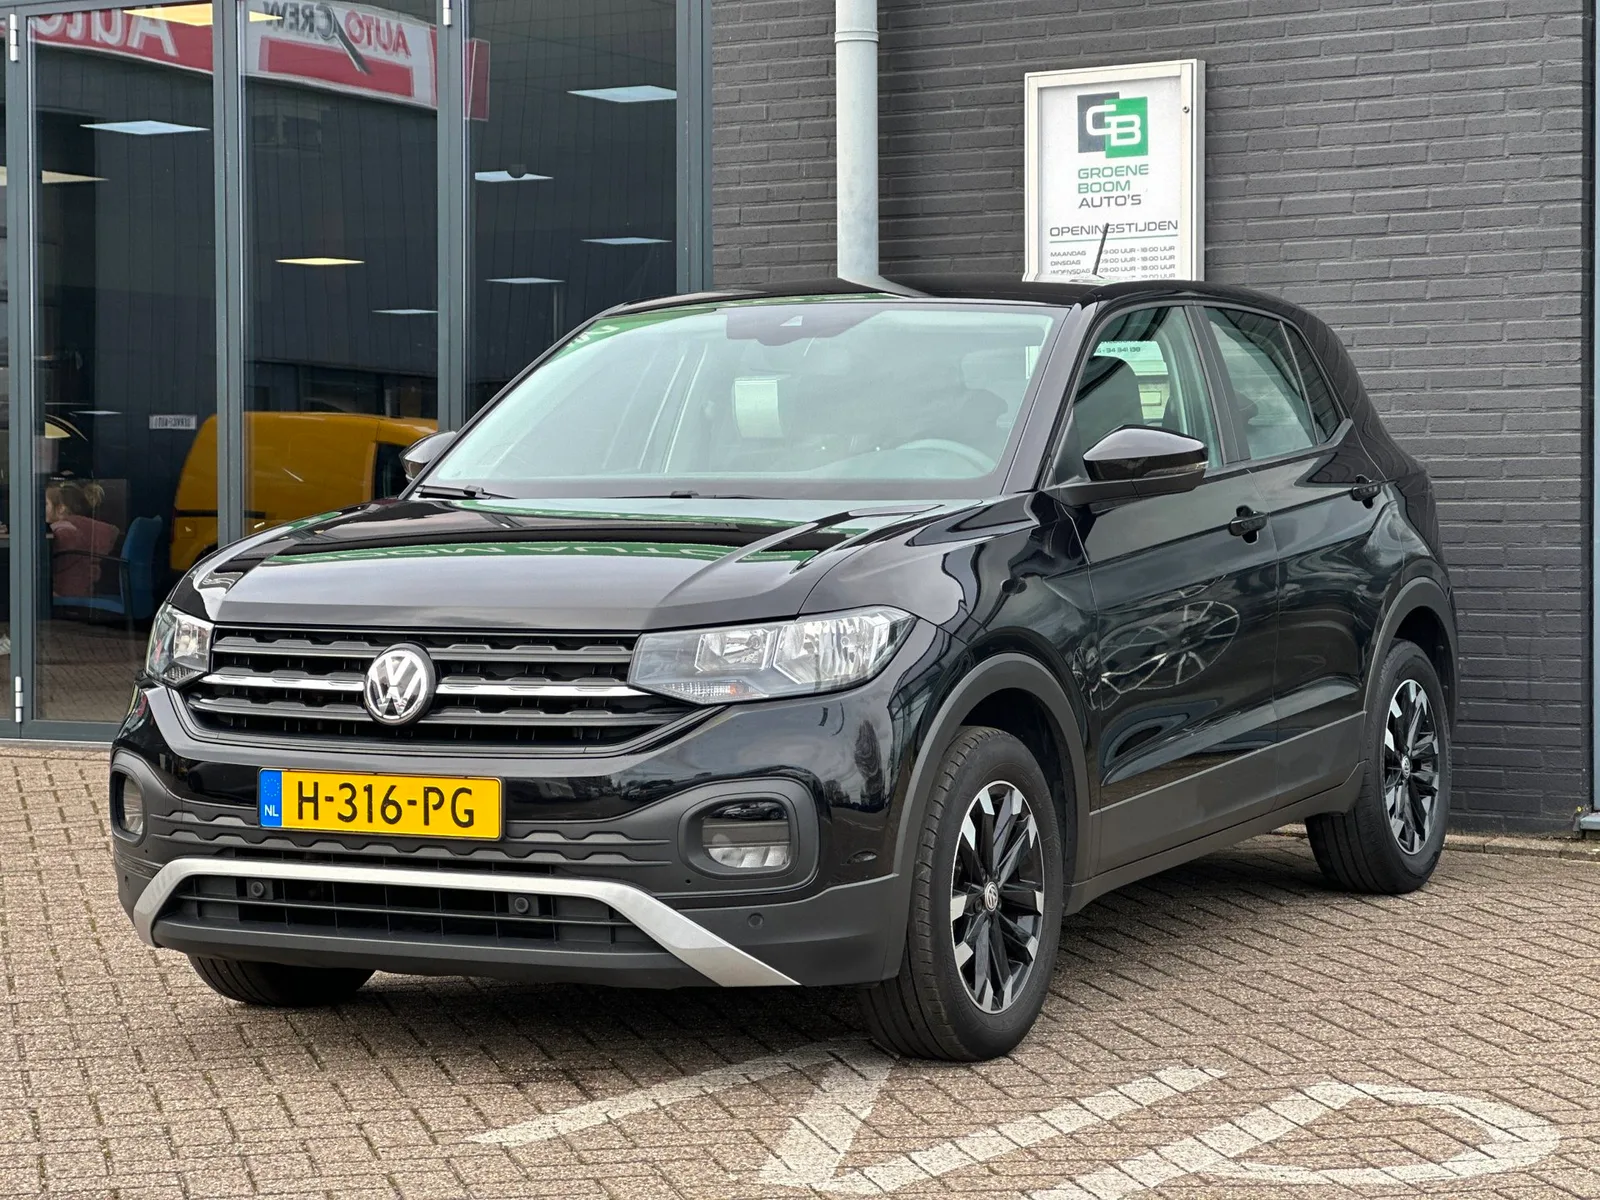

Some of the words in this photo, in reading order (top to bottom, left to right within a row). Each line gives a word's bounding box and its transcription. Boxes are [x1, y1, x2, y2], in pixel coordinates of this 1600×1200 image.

[1077, 163, 1150, 180] GROENE
[1077, 180, 1131, 194] BOOM
[1078, 193, 1142, 209] AUTO'S
[1049, 219, 1179, 237] OPENINGSTIJDEN
[1050, 250, 1087, 258] MAANDAG
[1050, 259, 1081, 267] DINSDAG
[263, 804, 279, 817] NL
[297, 780, 475, 828] H-316-PG
